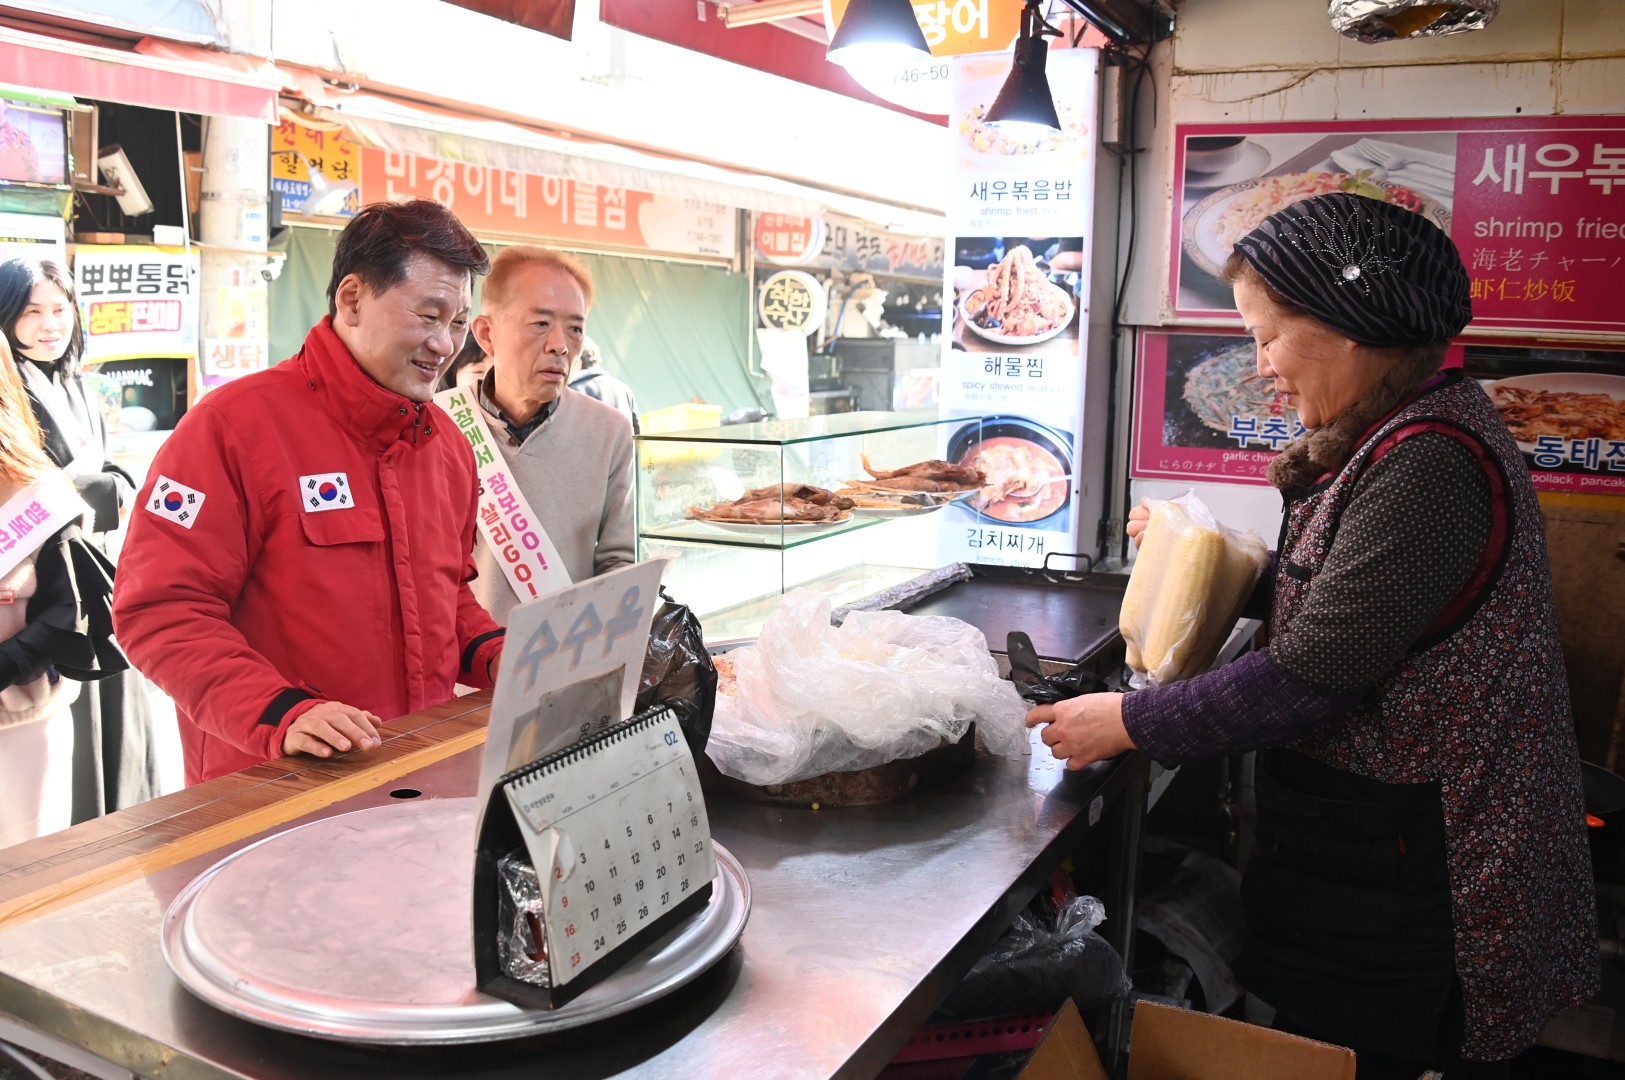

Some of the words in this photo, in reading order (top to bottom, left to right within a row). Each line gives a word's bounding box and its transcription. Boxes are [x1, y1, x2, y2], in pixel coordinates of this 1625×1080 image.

[970, 180, 1073, 201] 새우볶음밥
[980, 207, 1012, 216] shrimp
[1016, 207, 1037, 215] fried
[1474, 217, 1563, 242] shrimp
[81, 263, 196, 296] 뽀뽀통닭
[1470, 277, 1577, 303] 虾仁炒饭
[212, 344, 263, 369] 생닭
[984, 356, 1043, 378] 해물찜
[962, 381, 985, 390] spicy
[990, 383, 1023, 391] stewed
[449, 393, 495, 469] 시장에서
[1223, 451, 1249, 462] garlic
[1531, 473, 1574, 485] pollack
[487, 471, 549, 570] 장보GO!
[480, 502, 539, 599] 살리GO!
[967, 528, 1044, 555] 김치찌개
[664, 731, 679, 747] 02
[679, 767, 685, 777] 1
[554, 867, 562, 879] 2
[580, 852, 587, 864] 3
[604, 839, 610, 850] 4
[626, 826, 632, 837] 5
[647, 814, 654, 825] 6
[667, 802, 673, 813] 7
[686, 791, 692, 801] 8
[561, 896, 568, 908] 9
[584, 880, 595, 893] 10
[609, 866, 618, 878] 11
[630, 852, 640, 865] 12
[652, 840, 661, 852] 13
[672, 827, 681, 839] 14
[690, 816, 699, 827] 15
[565, 924, 575, 938] 16
[590, 908, 599, 922] 17
[612, 893, 622, 906] 18
[635, 879, 644, 892] 19
[656, 865, 666, 879] 20
[677, 853, 686, 866] 21
[694, 841, 703, 853] 22
[570, 952, 581, 968] 23
[594, 936, 605, 951] 24
[616, 920, 627, 934] 25
[638, 905, 649, 919] 26
[661, 892, 669, 905] 27
[680, 879, 689, 891] 28
